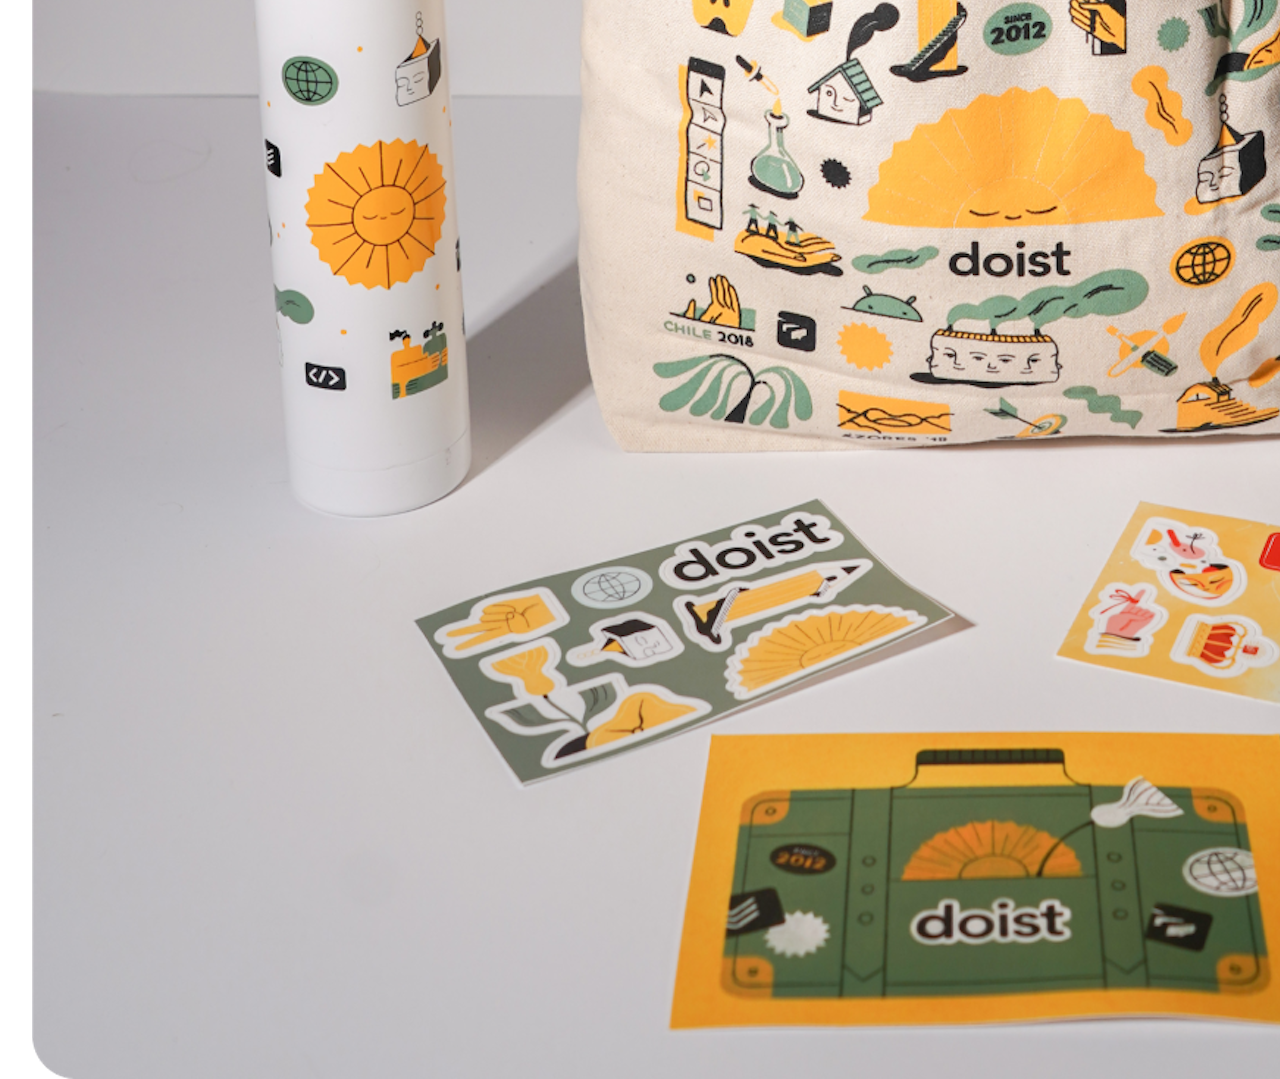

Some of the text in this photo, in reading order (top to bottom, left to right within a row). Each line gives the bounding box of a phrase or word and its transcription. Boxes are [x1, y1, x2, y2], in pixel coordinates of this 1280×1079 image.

[1004, 12, 1032, 25] SINCE
[990, 21, 1046, 45] 2012
[948, 240, 1072, 277] doist
[663, 320, 754, 348] CHILE 2018
[673, 518, 831, 582] doist
[776, 850, 827, 871] 2012
[916, 902, 1065, 940] doist
